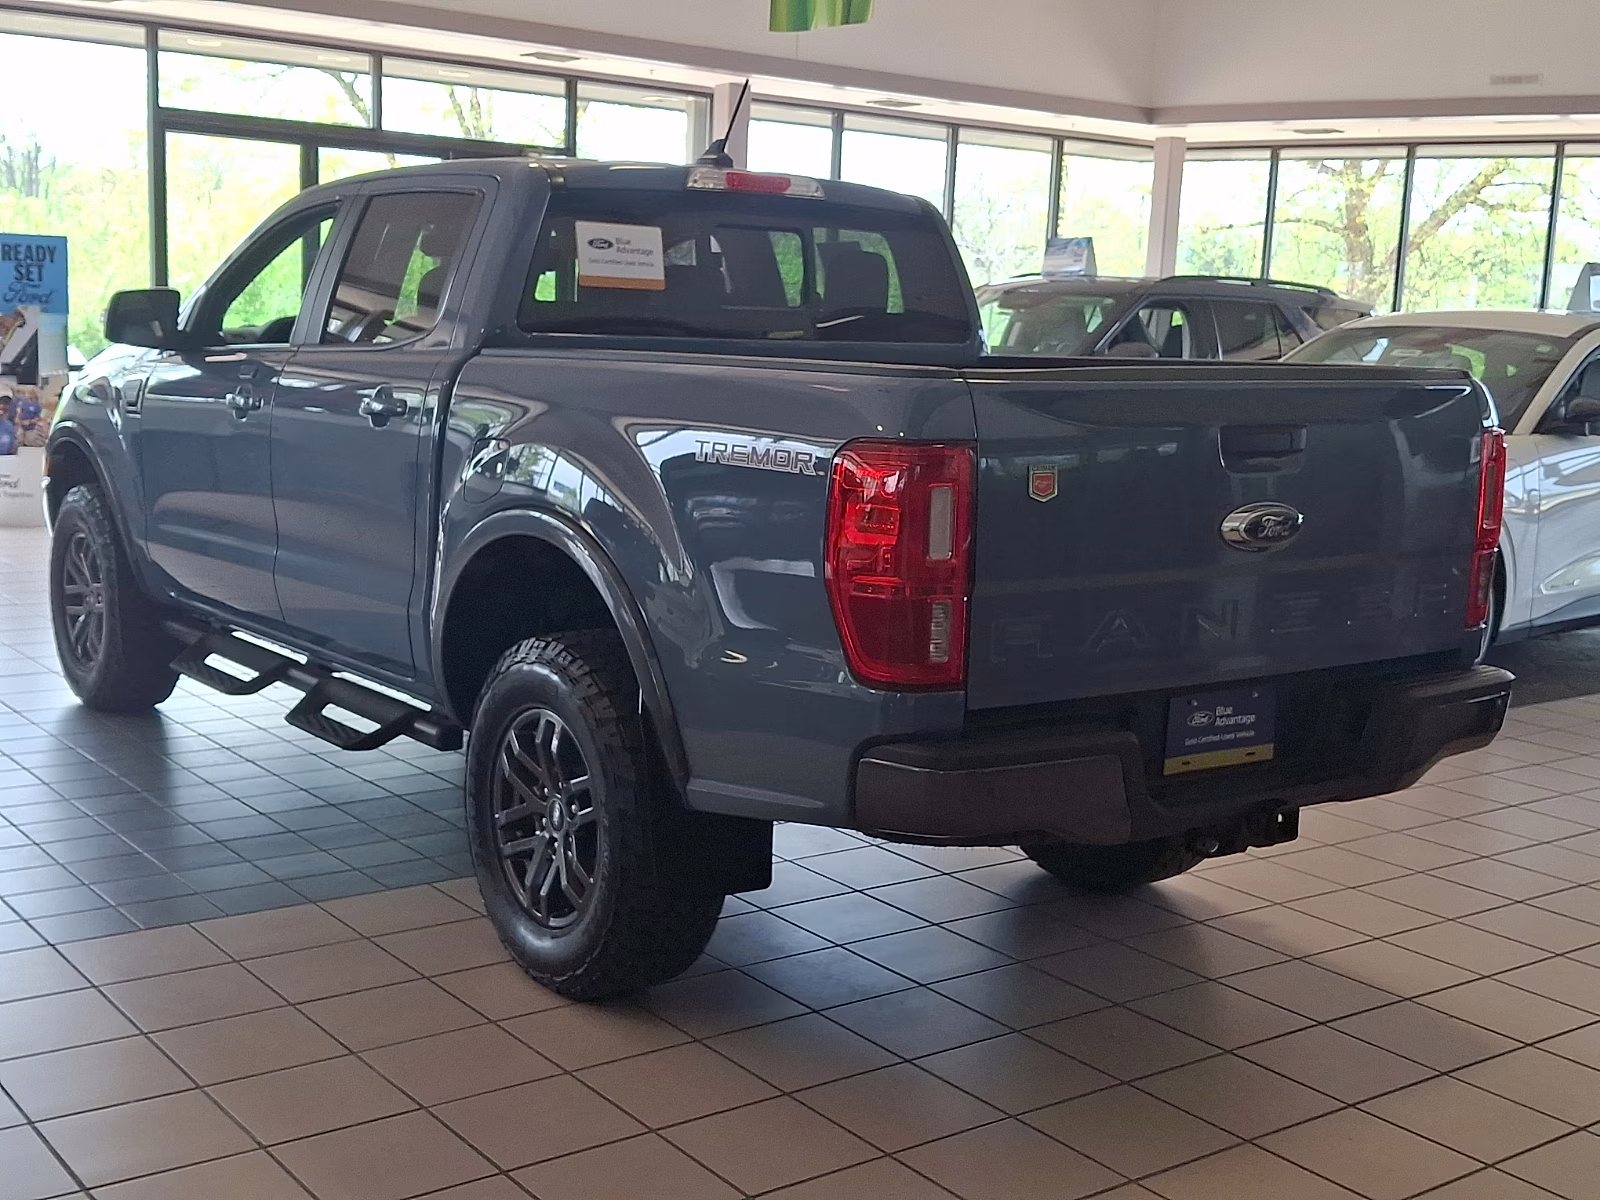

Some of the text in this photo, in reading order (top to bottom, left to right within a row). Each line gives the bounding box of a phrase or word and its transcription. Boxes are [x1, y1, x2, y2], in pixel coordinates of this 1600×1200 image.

[616, 237, 631, 246] Blue
[1, 243, 56, 263] READY
[616, 246, 654, 256] Advantage
[14, 263, 44, 282] SET
[4, 281, 56, 304] Ford
[695, 439, 817, 476] TREMOR
[1257, 515, 1292, 538] Ford
[1216, 706, 1233, 716] Blue
[1215, 714, 1256, 725] Advantage
[1198, 734, 1220, 743] Certified
[1221, 732, 1235, 741] Used
